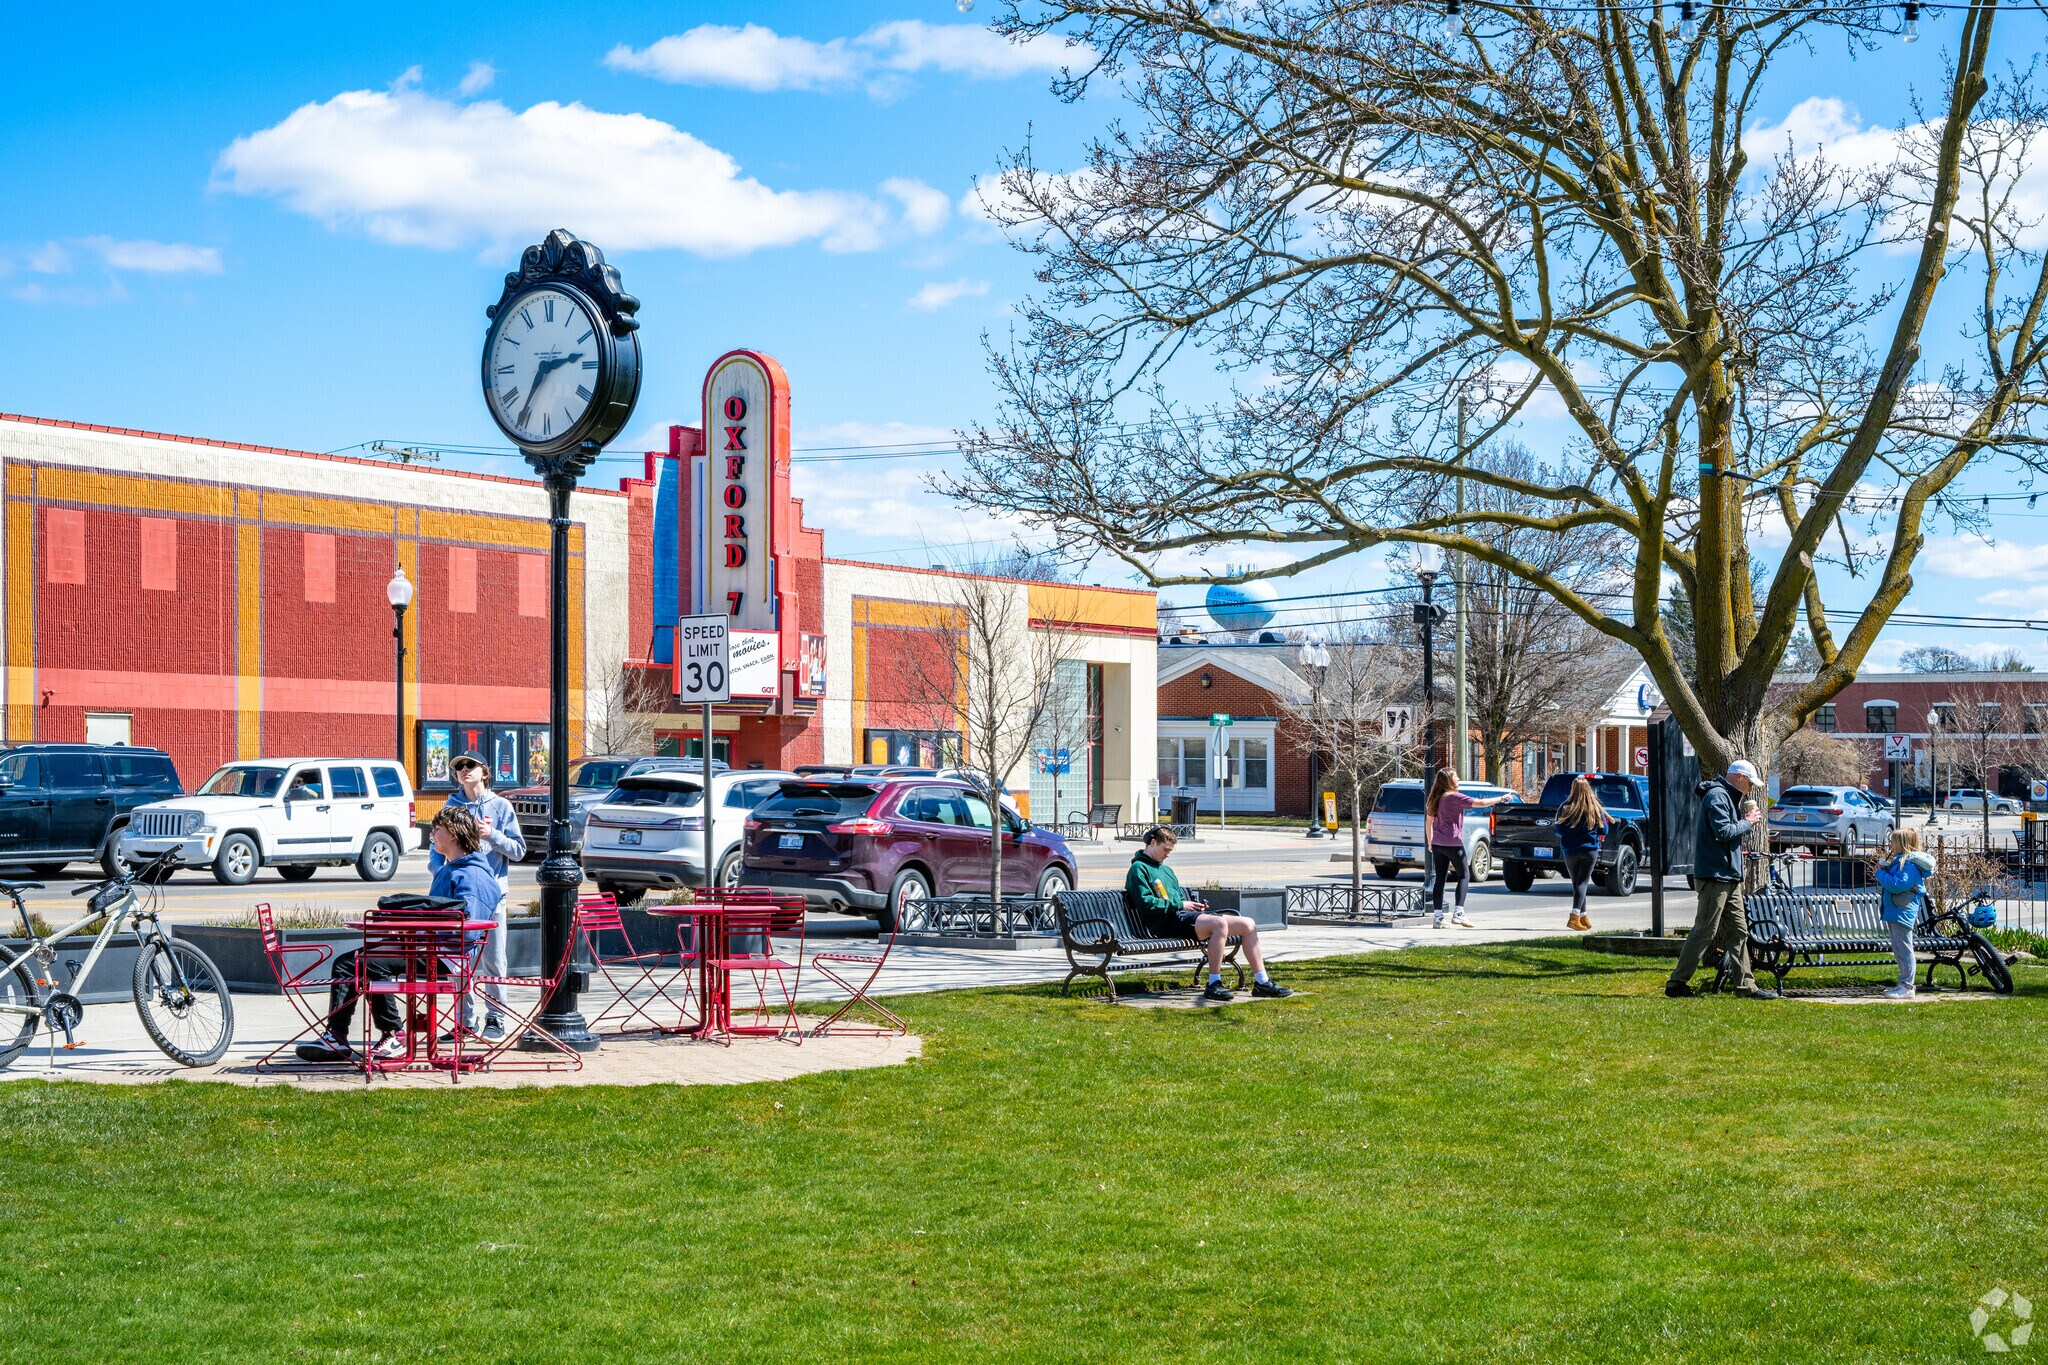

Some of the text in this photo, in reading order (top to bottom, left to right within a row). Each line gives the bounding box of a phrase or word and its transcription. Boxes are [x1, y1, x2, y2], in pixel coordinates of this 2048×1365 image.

[724, 396, 747, 616] OXFORD 7
[684, 625, 725, 639] SPEED
[688, 643, 720, 657] LIMIT
[733, 639, 770, 658] movies.
[729, 653, 776, 675] ATCH. SNACK. EARN.
[687, 662, 724, 693] 30
[761, 686, 775, 694] GQT
[95, 922, 113, 950] retrospec
